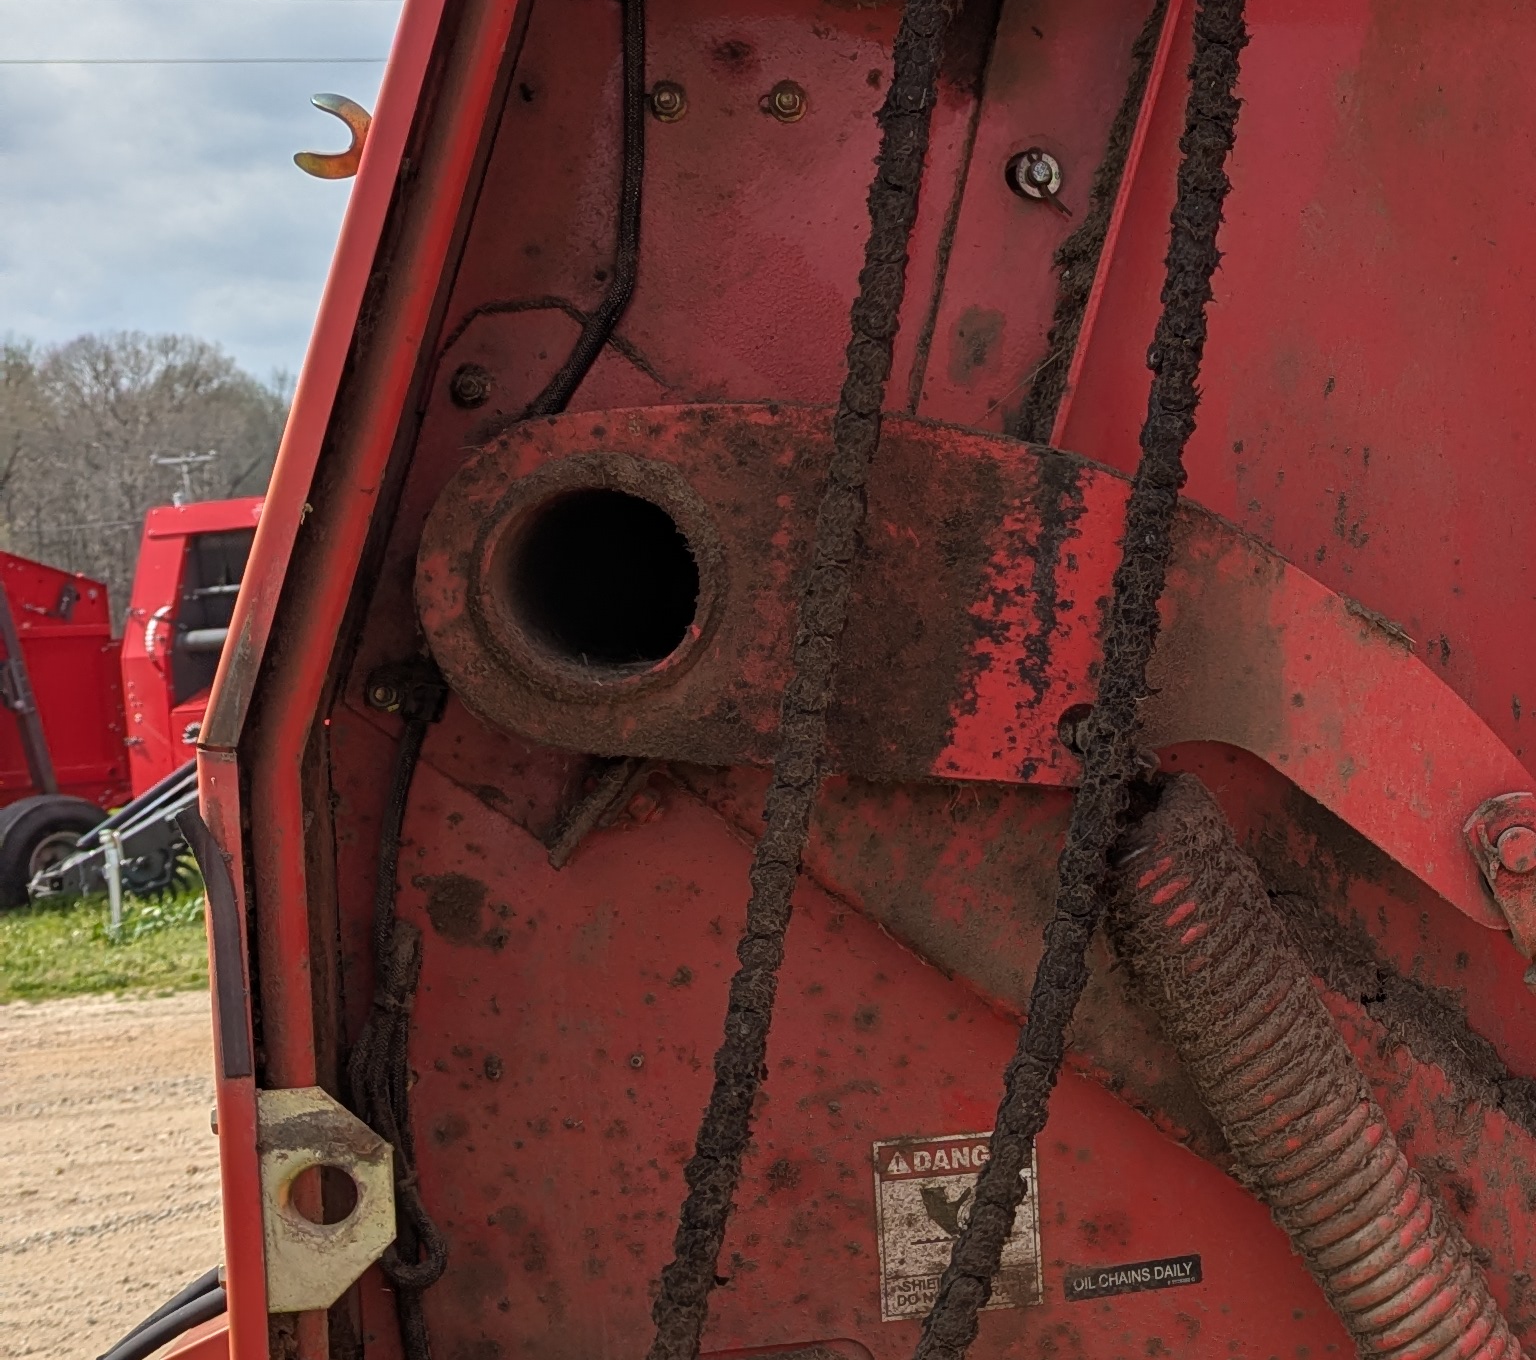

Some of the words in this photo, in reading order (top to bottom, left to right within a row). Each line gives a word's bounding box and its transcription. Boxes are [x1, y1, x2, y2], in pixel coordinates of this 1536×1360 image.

[913, 1144, 991, 1172] DANG
[1073, 1276, 1096, 1292] OIL
[1098, 1268, 1151, 1289] CHAINS
[1154, 1261, 1193, 1281] DAILY
